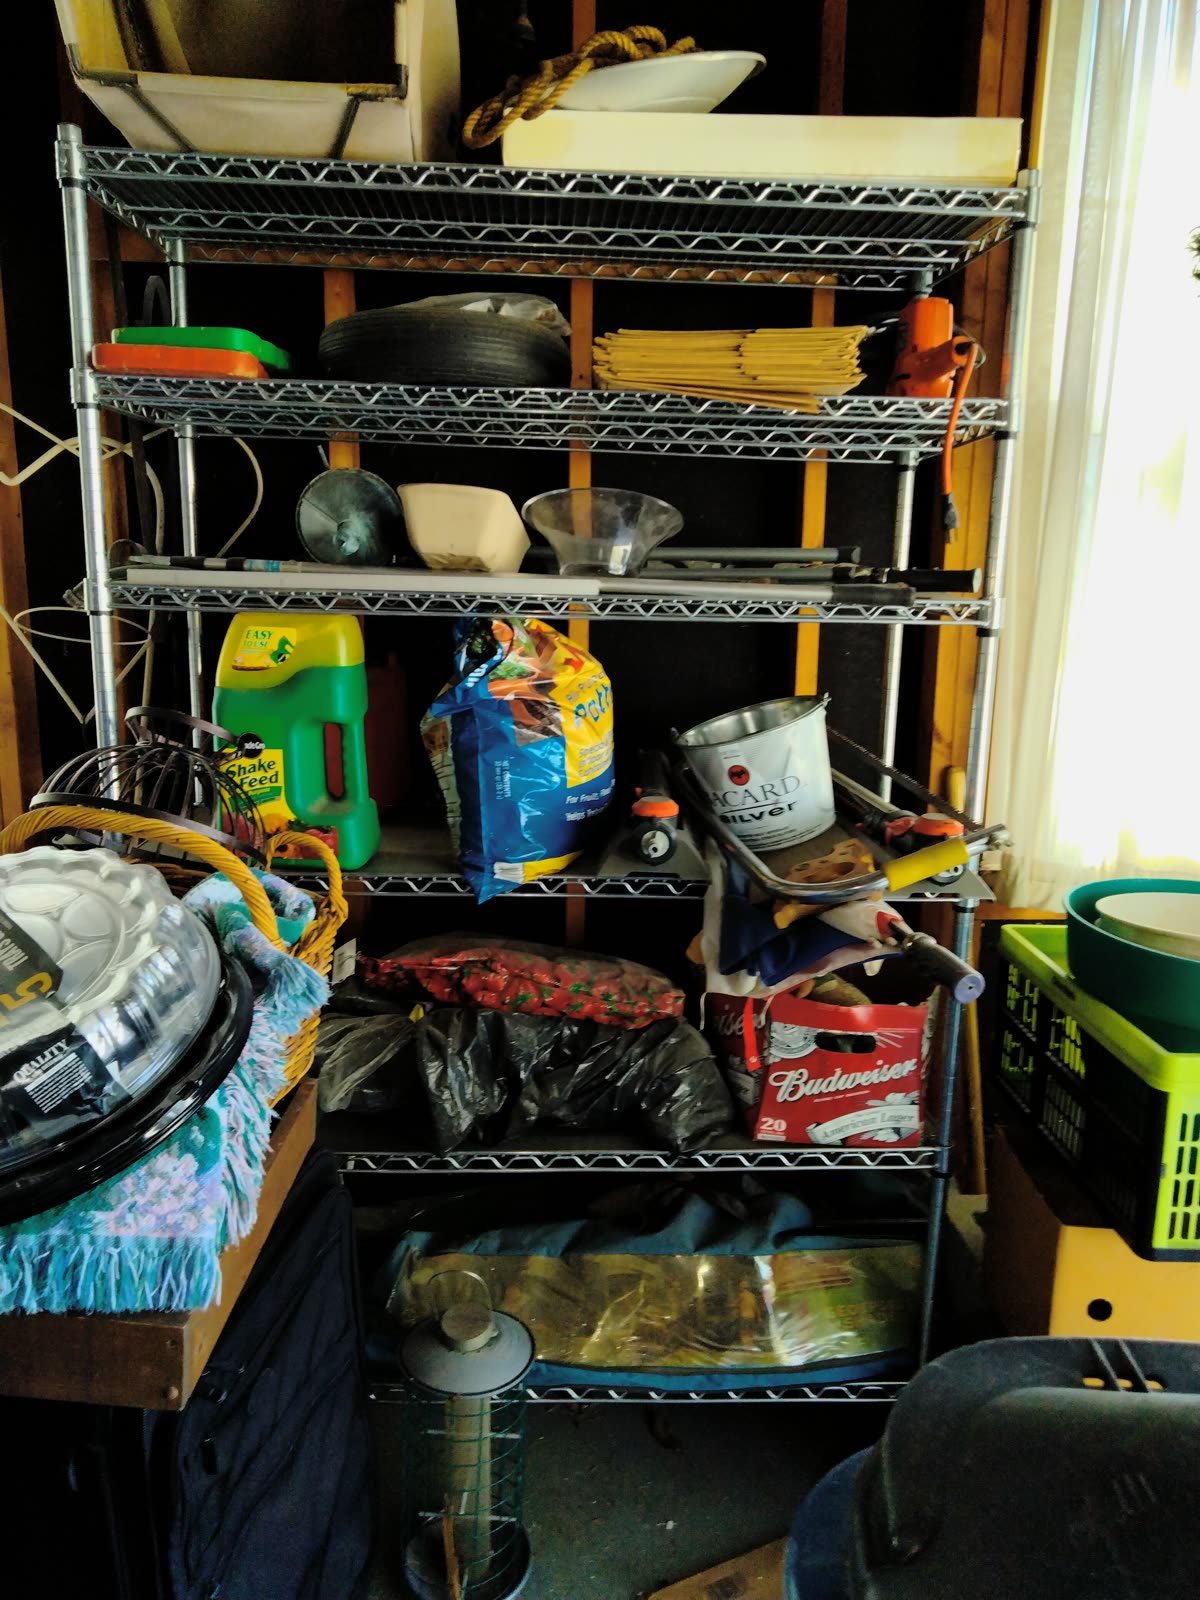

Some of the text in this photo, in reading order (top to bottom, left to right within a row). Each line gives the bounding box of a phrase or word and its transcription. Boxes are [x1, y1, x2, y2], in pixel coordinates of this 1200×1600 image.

[245, 629, 272, 640] EASY
[225, 758, 276, 778] Shake
[239, 770, 279, 788] Feed
[13, 1038, 70, 1083] QUALITY
[768, 1058, 919, 1103] Budweiser
[759, 1116, 787, 1132] 20
